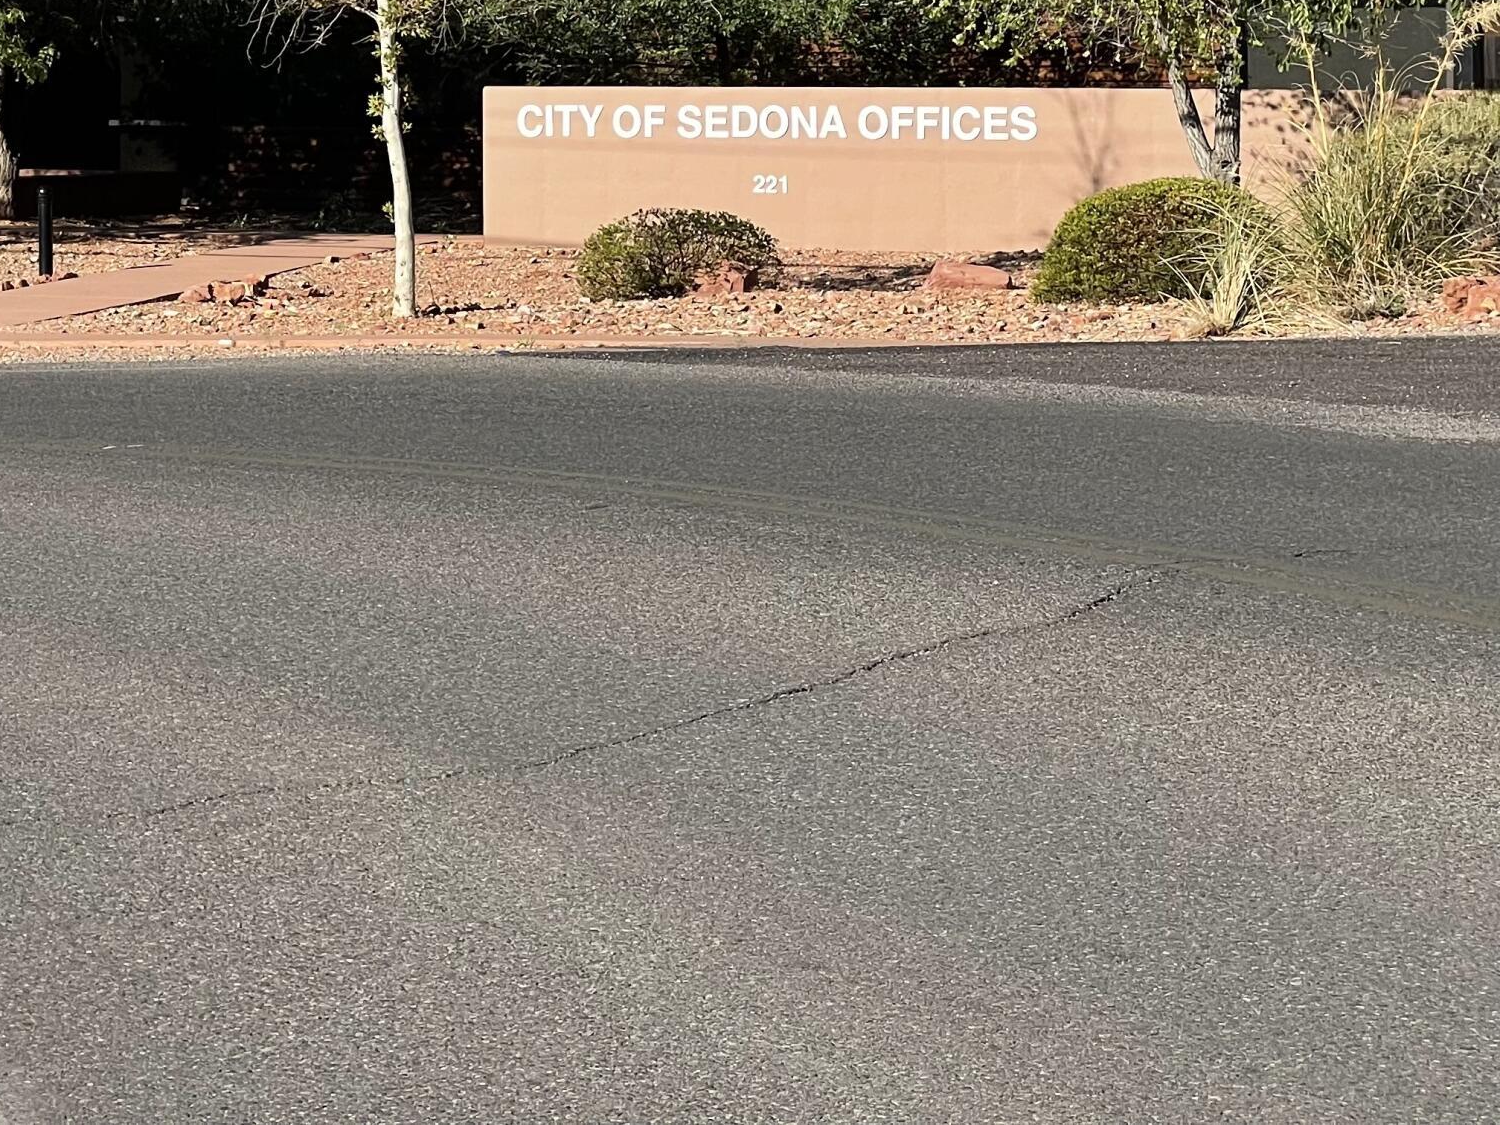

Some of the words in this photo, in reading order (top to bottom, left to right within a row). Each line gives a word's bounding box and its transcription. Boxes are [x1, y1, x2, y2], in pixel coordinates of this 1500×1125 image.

[517, 104, 603, 138] CITY
[612, 105, 666, 139] OF
[677, 105, 847, 140] SEDONA
[857, 105, 1038, 141] OFFICES
[752, 175, 789, 194] 221
